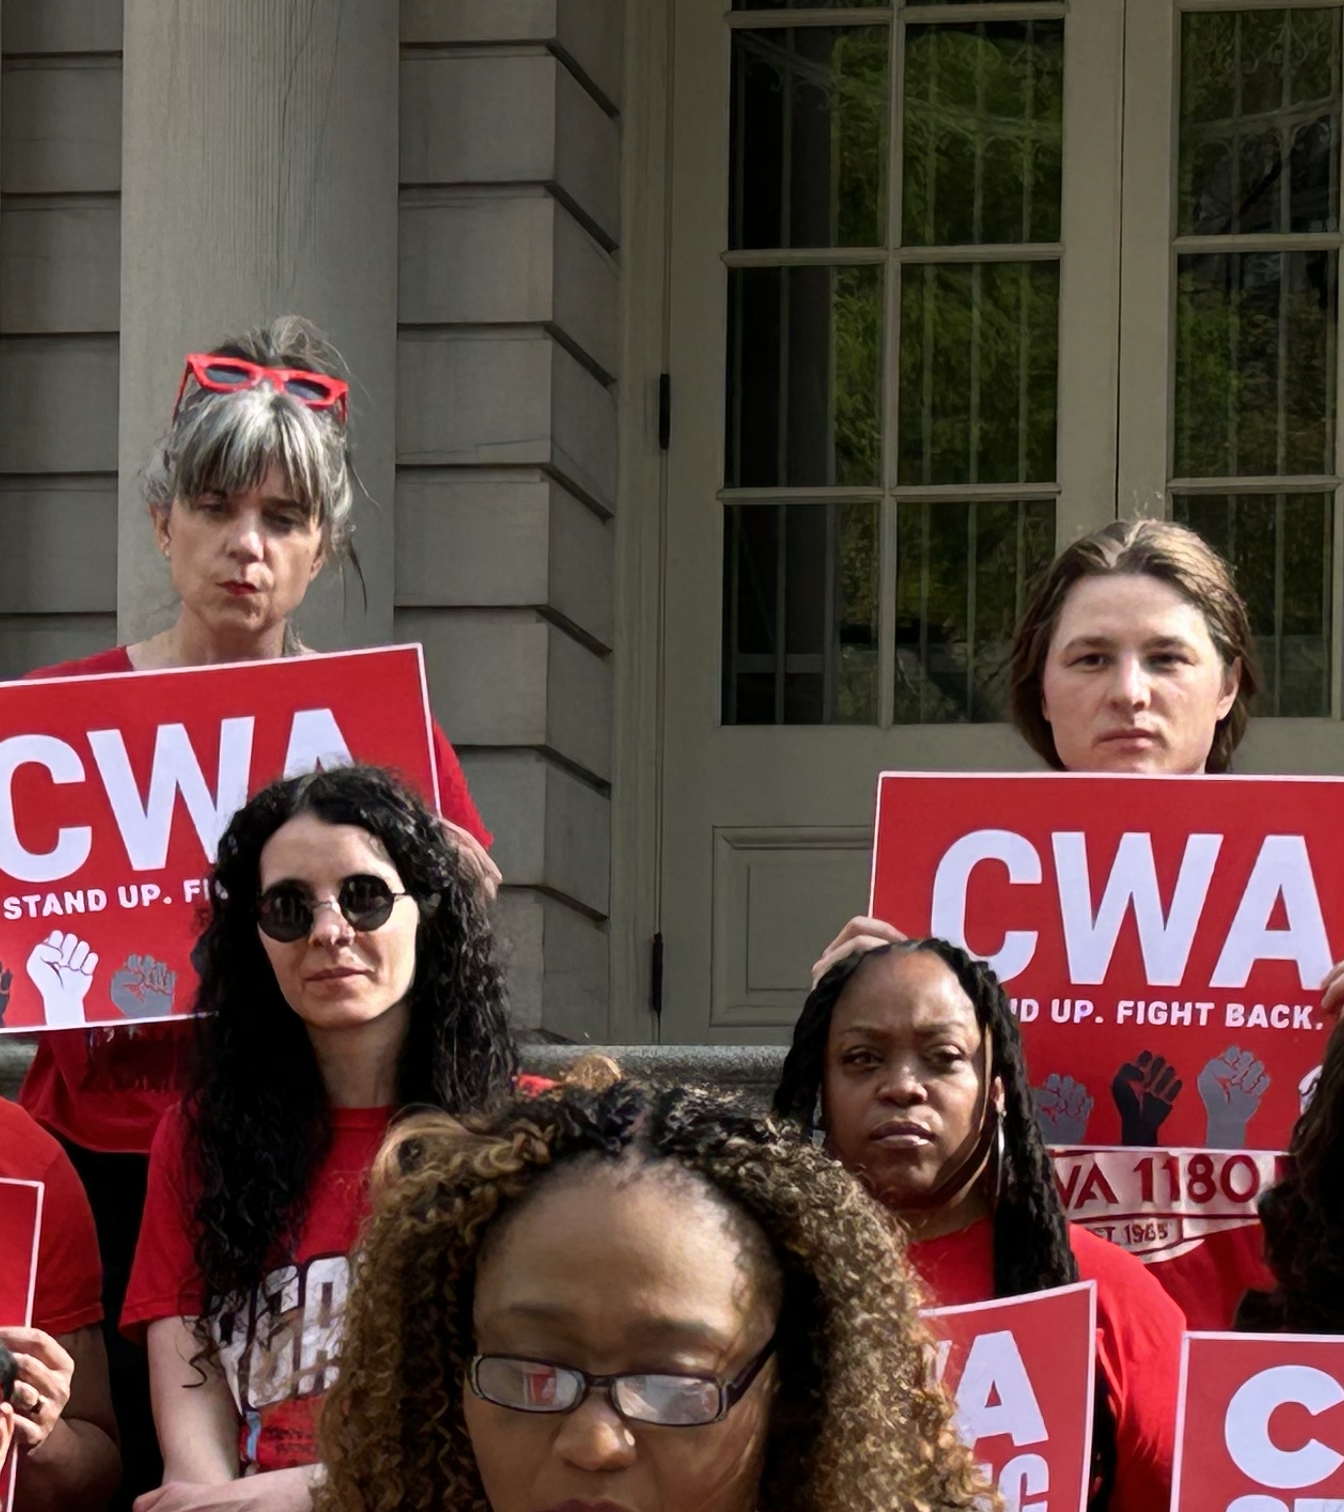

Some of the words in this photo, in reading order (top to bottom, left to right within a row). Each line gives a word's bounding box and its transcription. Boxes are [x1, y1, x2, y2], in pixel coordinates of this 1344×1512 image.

[3, 888, 108, 921] STAND
[116, 883, 173, 909] UP.
[930, 828, 1334, 990] CWA
[1051, 998, 1104, 1024] UP.
[1116, 1000, 1215, 1027] FIGHT
[1224, 1003, 1324, 1031] BACK.
[1132, 1154, 1261, 1204] 1180
[921, 1329, 1050, 1448] A
